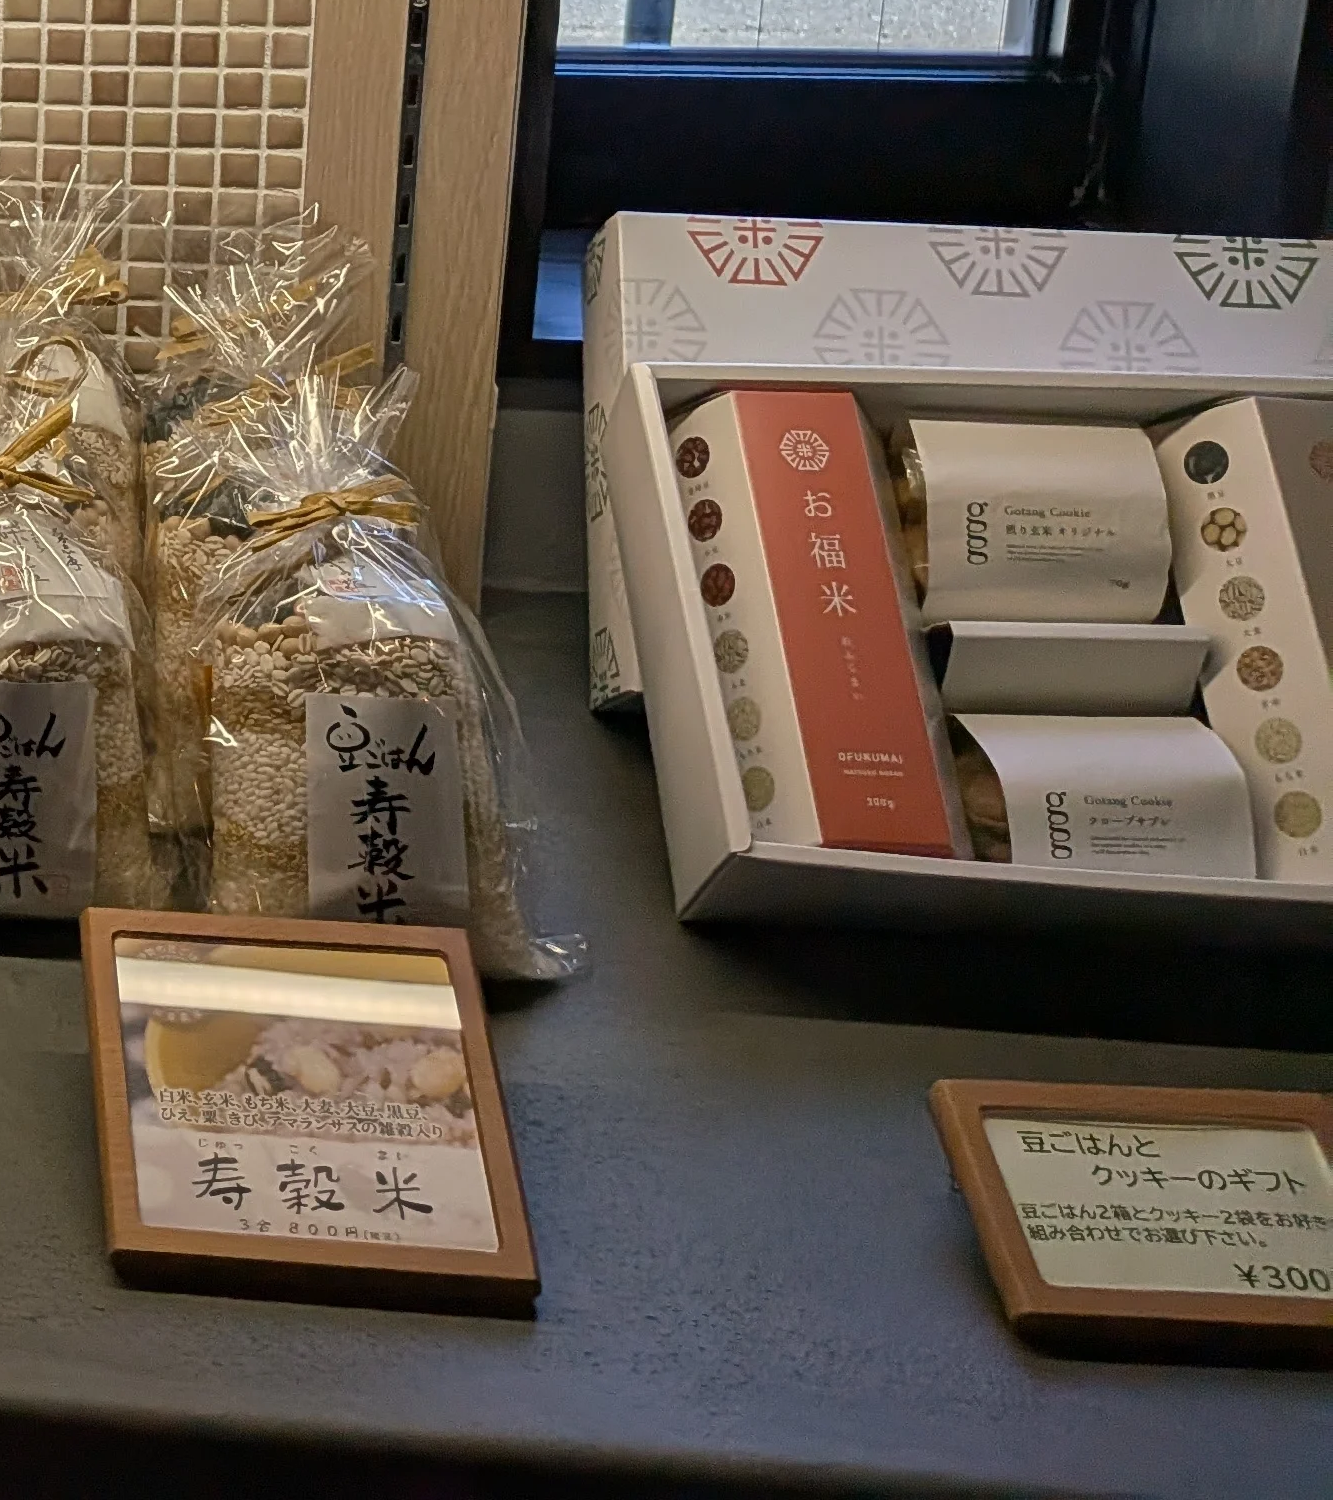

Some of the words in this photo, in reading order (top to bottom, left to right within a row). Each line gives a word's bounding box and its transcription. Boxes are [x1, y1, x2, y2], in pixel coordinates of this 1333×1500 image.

[803, 489, 859, 618] お福米
[347, 775, 415, 925] 寿穀米
[159, 1088, 428, 1121] 白米、玄米、もち米、大麦、大豆、黒豆、
[1017, 1129, 1161, 1158] 豆ごはんと
[191, 1152, 434, 1221] 寿穀米
[1091, 1164, 1306, 1194] クッキーのギフト
[1018, 1202, 1333, 1233] 豆ごはん2箱とクッキー2袋をお好き
[1027, 1223, 1268, 1249] 組み合わせでお選び下さい。
[1233, 1263, 1333, 1293] ¥300
